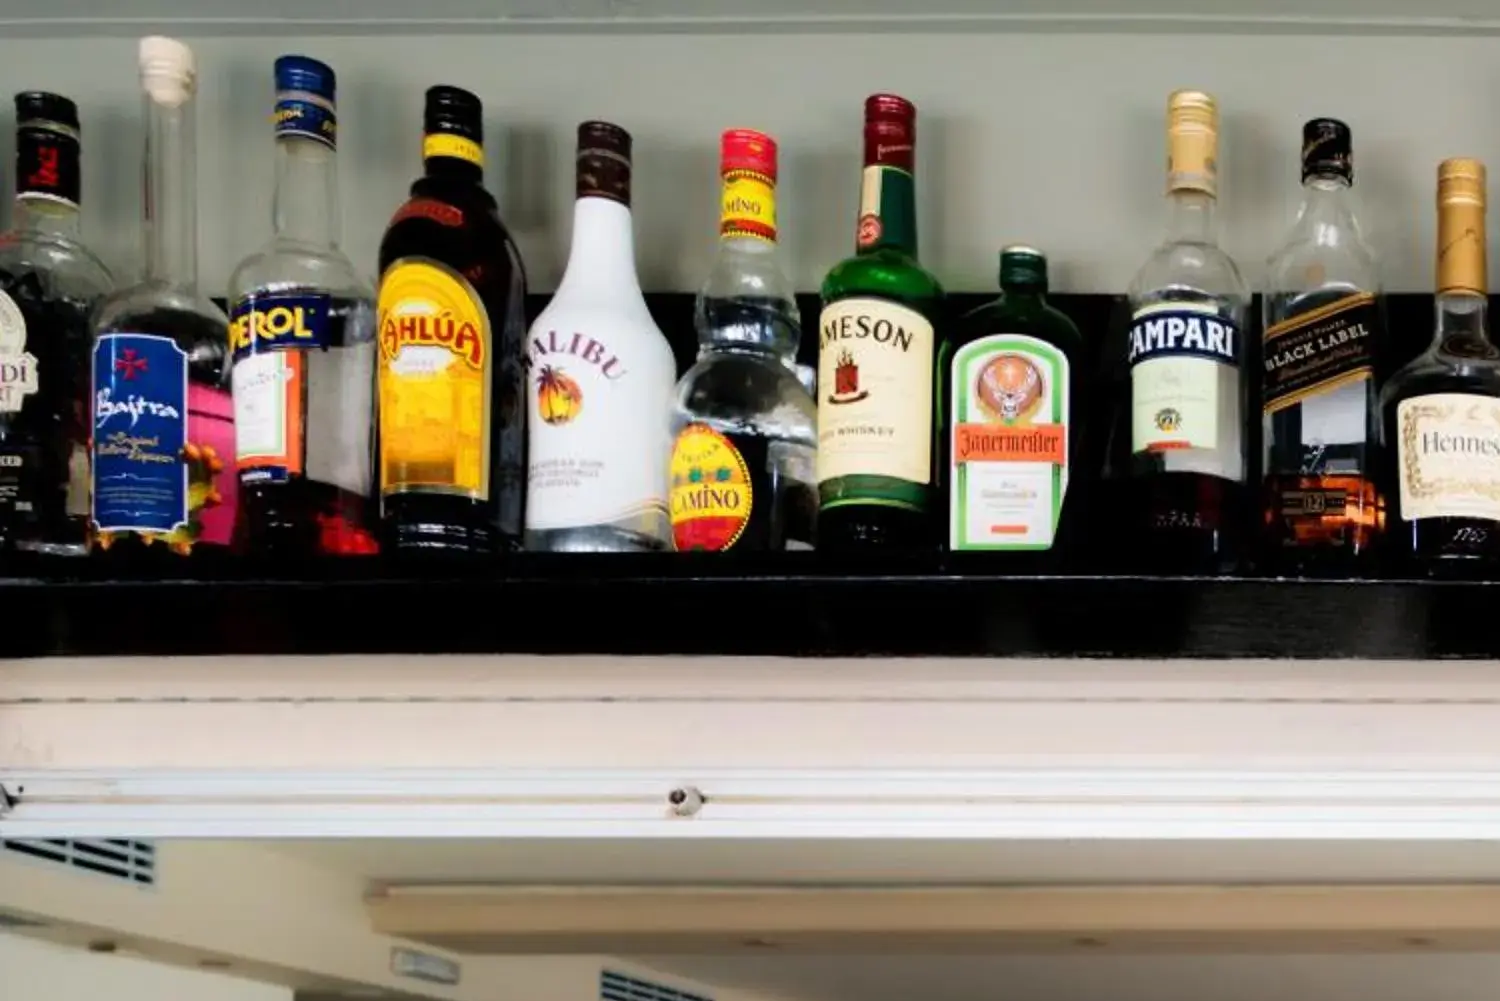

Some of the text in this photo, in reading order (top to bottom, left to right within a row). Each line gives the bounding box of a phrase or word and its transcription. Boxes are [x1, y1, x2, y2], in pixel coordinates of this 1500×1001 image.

[379, 311, 482, 369] AHLÚA
[1265, 343, 1314, 372] BLACK
[1317, 323, 1368, 353] LABEL
